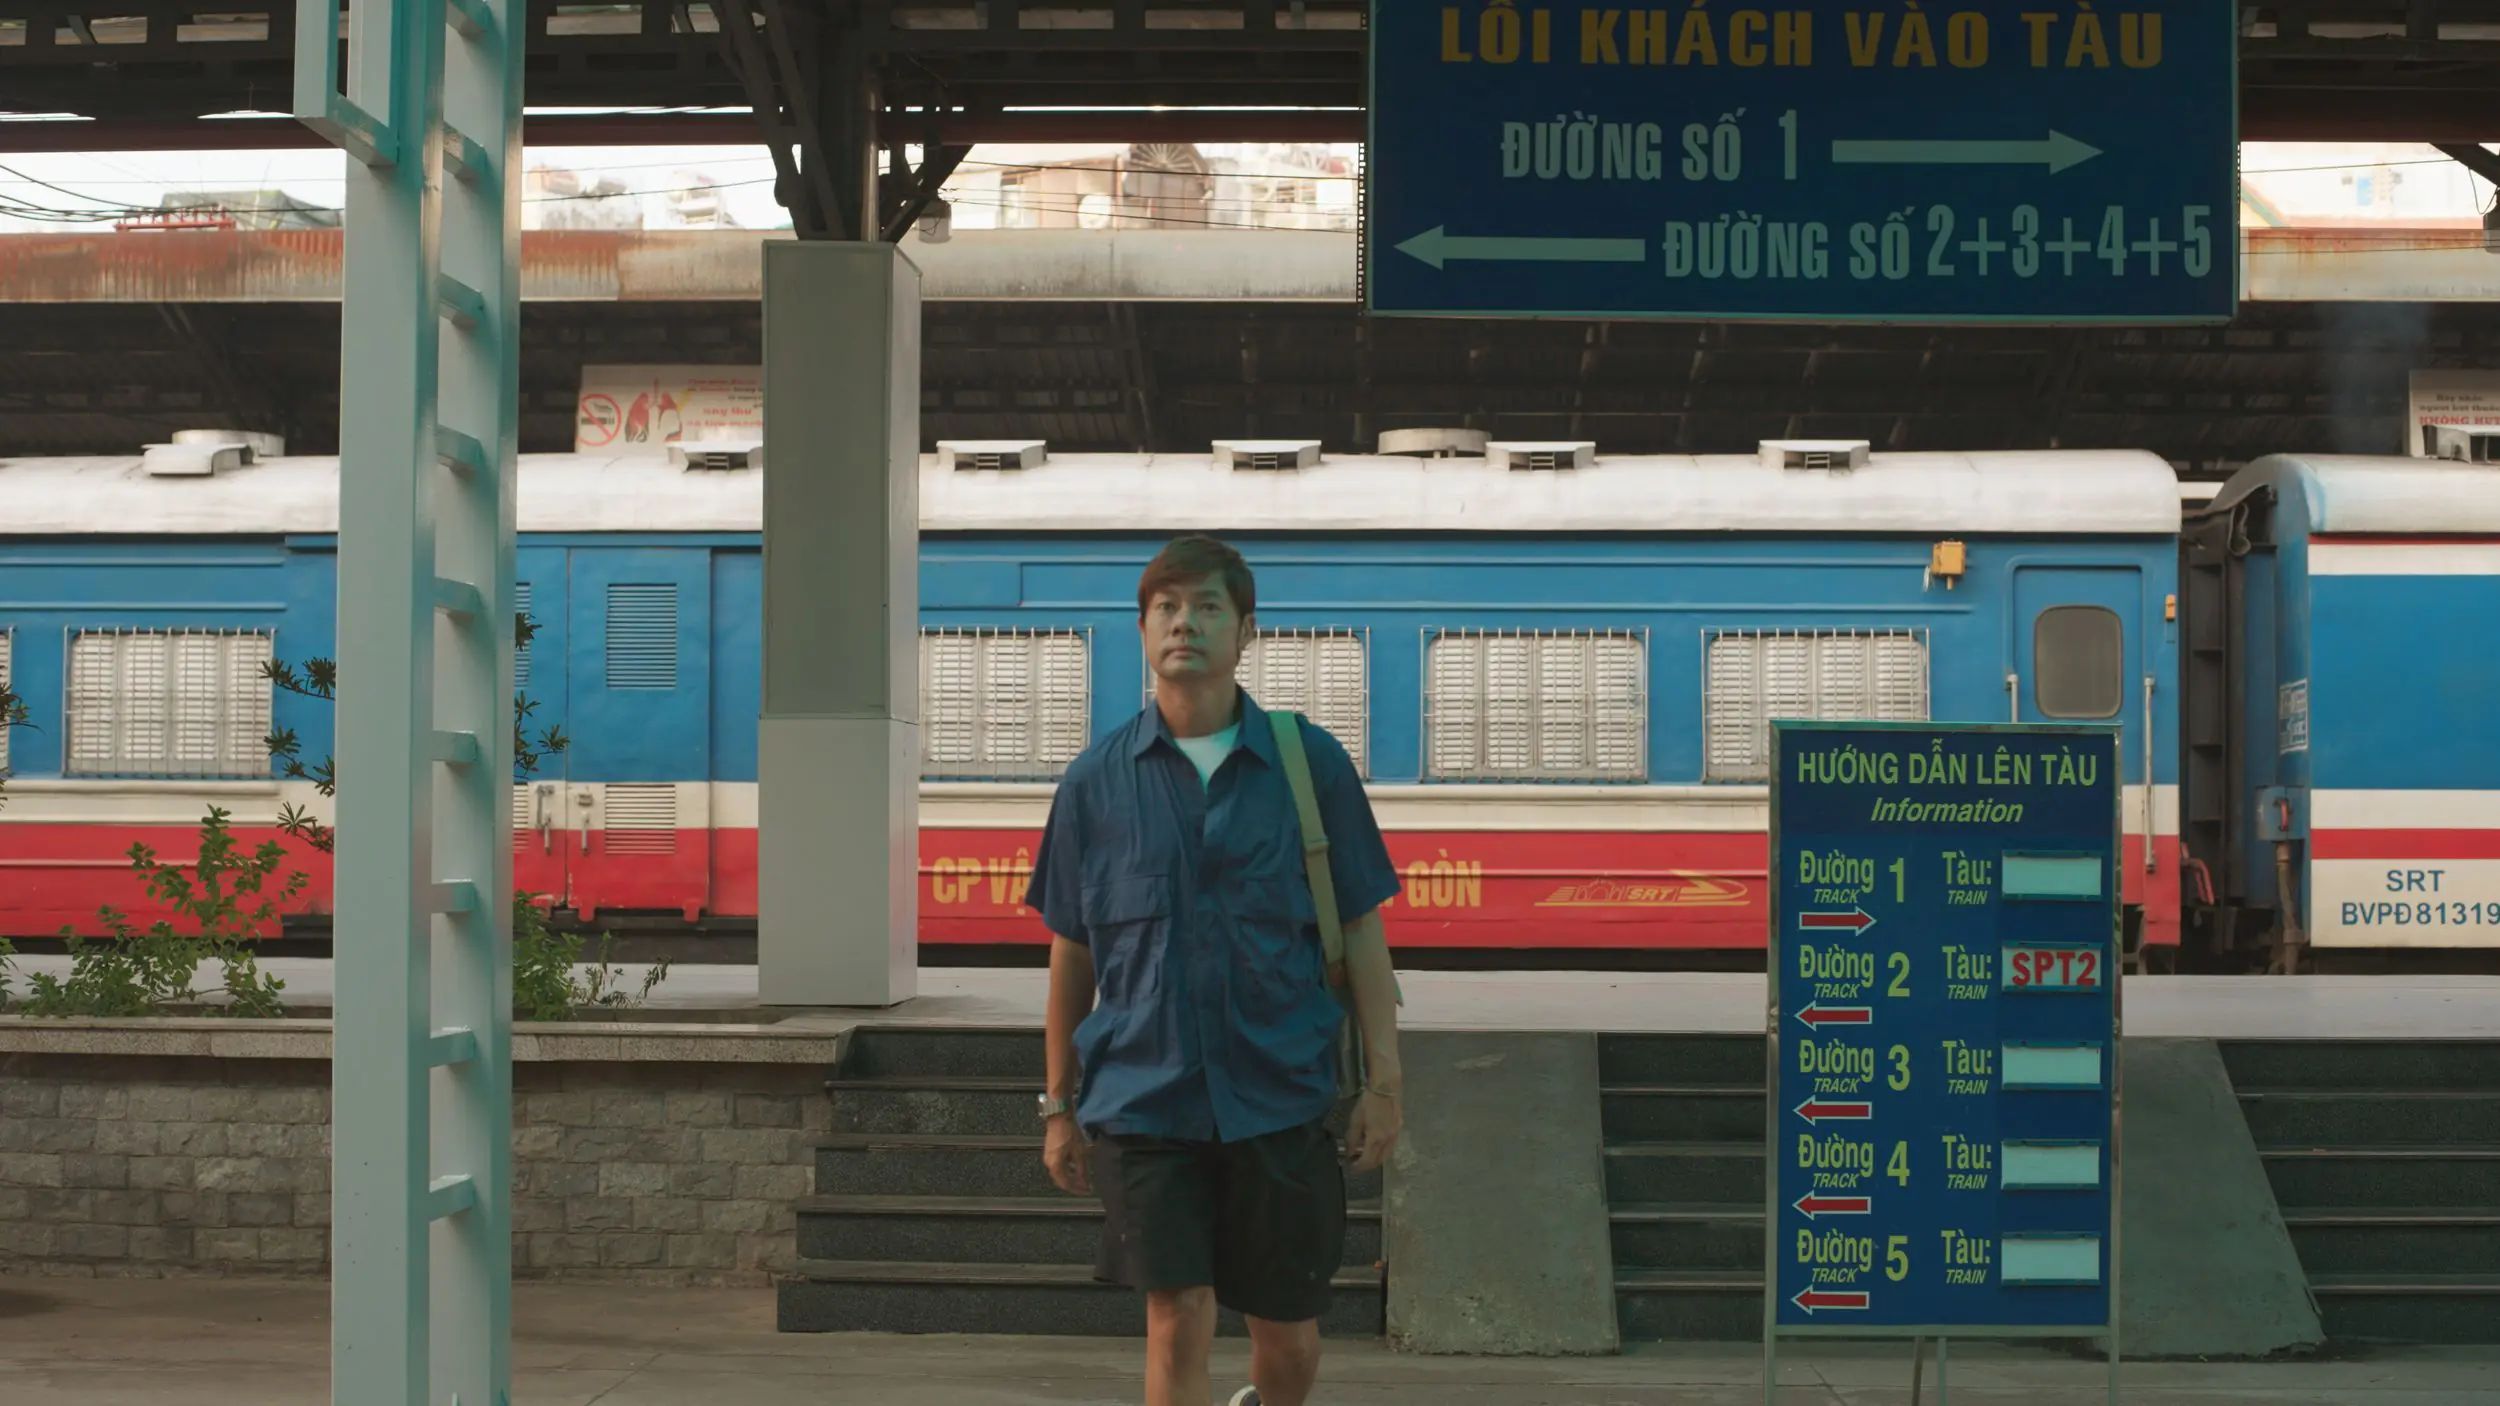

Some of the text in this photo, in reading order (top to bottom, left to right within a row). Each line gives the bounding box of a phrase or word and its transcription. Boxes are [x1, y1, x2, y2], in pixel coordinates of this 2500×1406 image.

[1580, 0, 1813, 66] KHÁCH
[1843, 1, 1989, 68] VÀO
[2020, 1, 2162, 68] TÀU
[1501, 107, 1797, 181] ĐƯỜNG SỐ 1
[1662, 210, 1829, 279] ĐƯỜNG
[1849, 206, 1915, 279] SỐ
[1798, 738, 2097, 786] HƯỚNG DẪN LÊN TÀU
[1870, 797, 2024, 823] Information
[932, 856, 982, 904] CP
[1407, 848, 1481, 908] GÒN
[1799, 850, 1993, 903] Đường 1 Tàu:
[1813, 889, 1988, 905] TRACK TRAIN
[2386, 870, 2445, 892] SRT
[1799, 945, 2097, 998] Đường 2 Tàu: SPT2
[1813, 984, 1988, 1000] TRACK TRAIN
[1799, 1039, 1993, 1091] Đường 3 Tàu:
[1813, 1078, 1988, 1094] TRACK TRAIN
[1798, 1134, 1992, 1187] Đường 4 Tàu:
[1812, 1173, 1987, 1189] TRACK TRAIN
[1797, 1229, 1991, 1281] Đường 5 Tàu:
[1811, 1268, 1986, 1284] TRACK TRAIN
